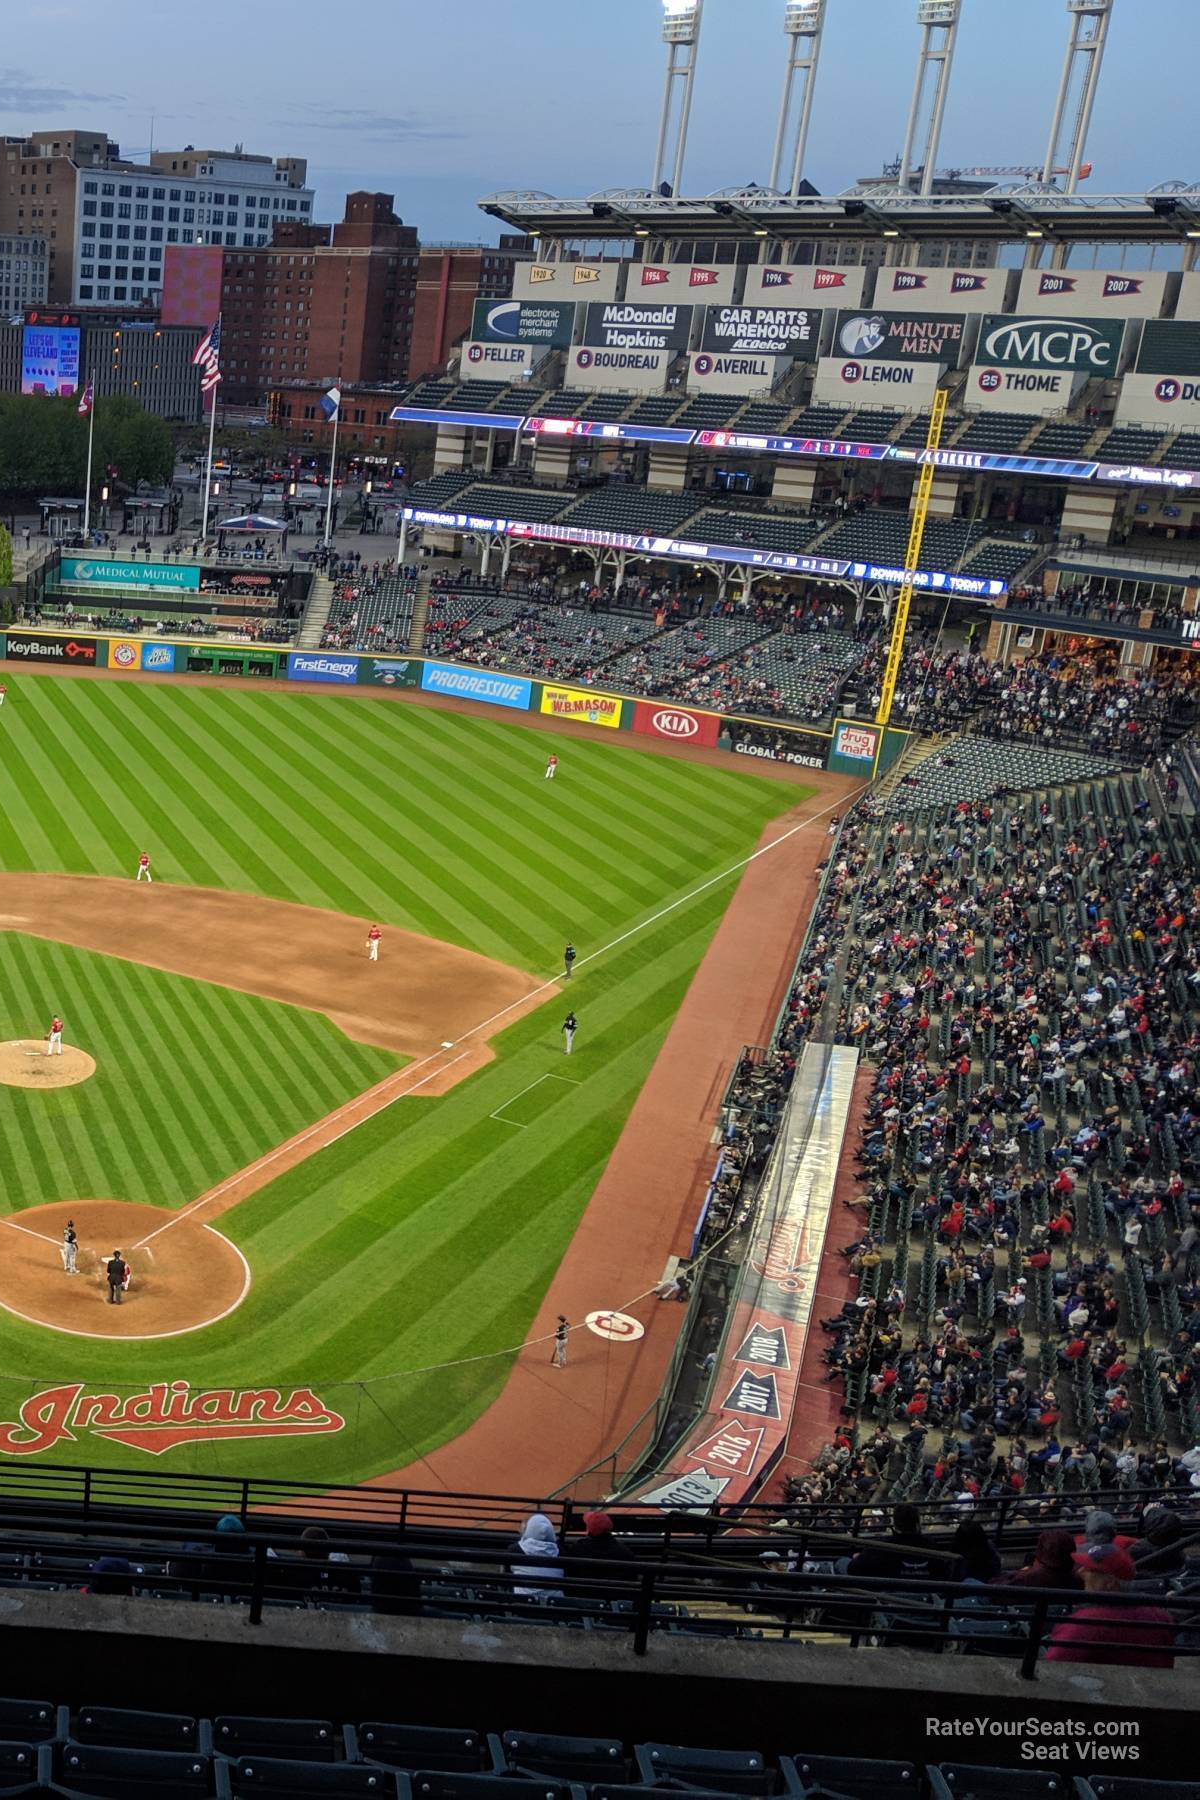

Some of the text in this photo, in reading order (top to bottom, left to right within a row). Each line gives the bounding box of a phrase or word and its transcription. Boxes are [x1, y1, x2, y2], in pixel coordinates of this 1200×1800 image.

[533, 270, 547, 279] 1920
[577, 270, 591, 280] 1948
[646, 271, 660, 282] 1954
[693, 272, 709, 282] 1995
[766, 273, 782, 284] 1996
[818, 273, 835, 285] 1997
[898, 276, 916, 286] 1998
[956, 277, 975, 288] 1999
[1044, 278, 1063, 290] 2001
[1108, 280, 1129, 292] 2007
[520, 308, 560, 319] electronic
[602, 306, 676, 324] McDonald
[720, 309, 807, 326] CAR PARTS
[519, 317, 558, 328] merchant
[888, 321, 961, 340] MINUTE
[518, 327, 553, 337] systems
[605, 330, 666, 349] Hopkins
[715, 323, 809, 340] WAREHOUSE
[732, 339, 788, 350] ACDelco
[901, 339, 943, 354] MEN
[1003, 331, 1111, 365] MCPc
[470, 347, 525, 363] 19 FELLER
[581, 353, 660, 369] 5 BOUDREAU
[700, 359, 768, 375] 3 AVERILL
[845, 365, 913, 384] 21 LEMON
[983, 373, 1061, 392] 25 THOME
[1160, 384, 1175, 396] 14
[95, 566, 185, 581] MEDICAL MUTUAL
[7, 640, 63, 657] KeyBank
[294, 658, 357, 678] FirstEnergy
[428, 670, 524, 700] PROGRESSIVE
[553, 699, 617, 713] W.B.MASON
[660, 715, 689, 733] KIA
[841, 727, 870, 747] drug
[736, 743, 823, 769] GLOBAL POKER
[841, 744, 874, 757] mart
[748, 1336, 780, 1363] 2018
[737, 1381, 771, 1412] 2017
[707, 1432, 752, 1466] 2016
